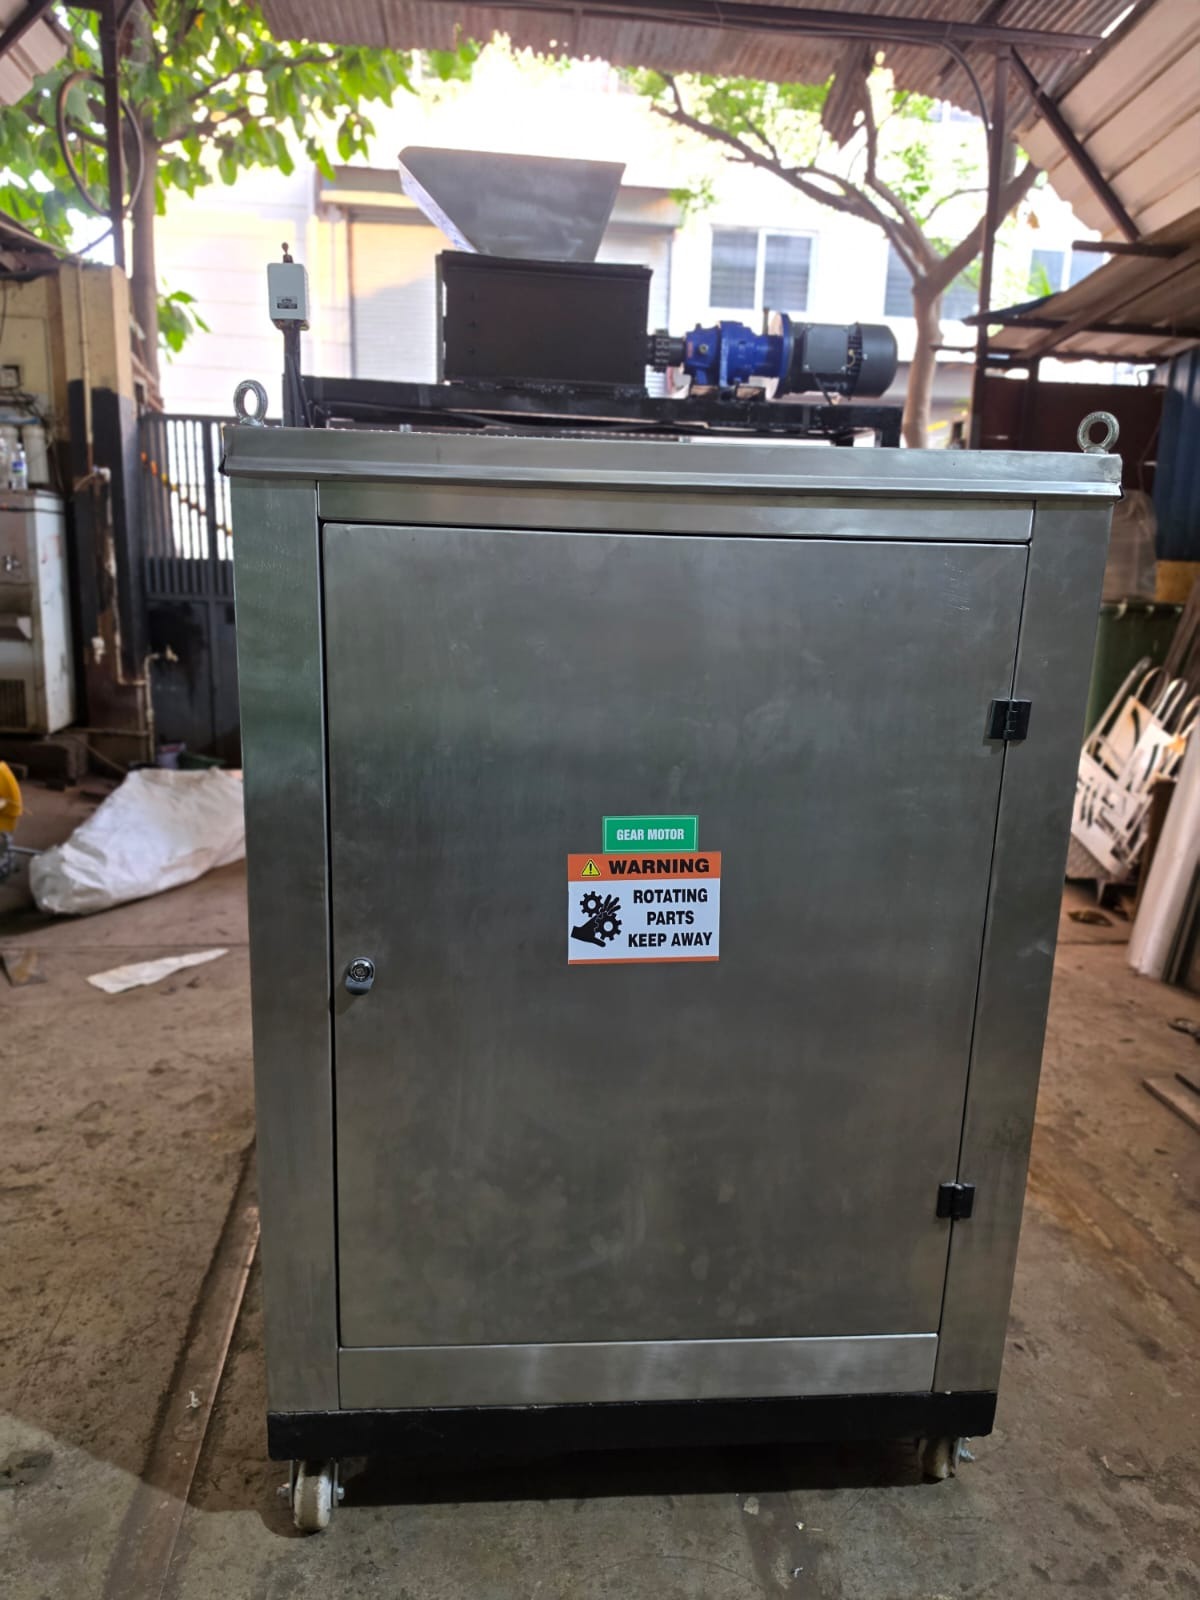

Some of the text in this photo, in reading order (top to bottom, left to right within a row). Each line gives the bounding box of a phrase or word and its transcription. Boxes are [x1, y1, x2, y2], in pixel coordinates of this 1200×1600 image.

[616, 828, 685, 841] GEAR MOTOR
[609, 858, 710, 875] WARNING
[633, 888, 708, 904] ROTATING
[646, 911, 695, 925] PARTS
[628, 932, 713, 948] KEEP AWAY
